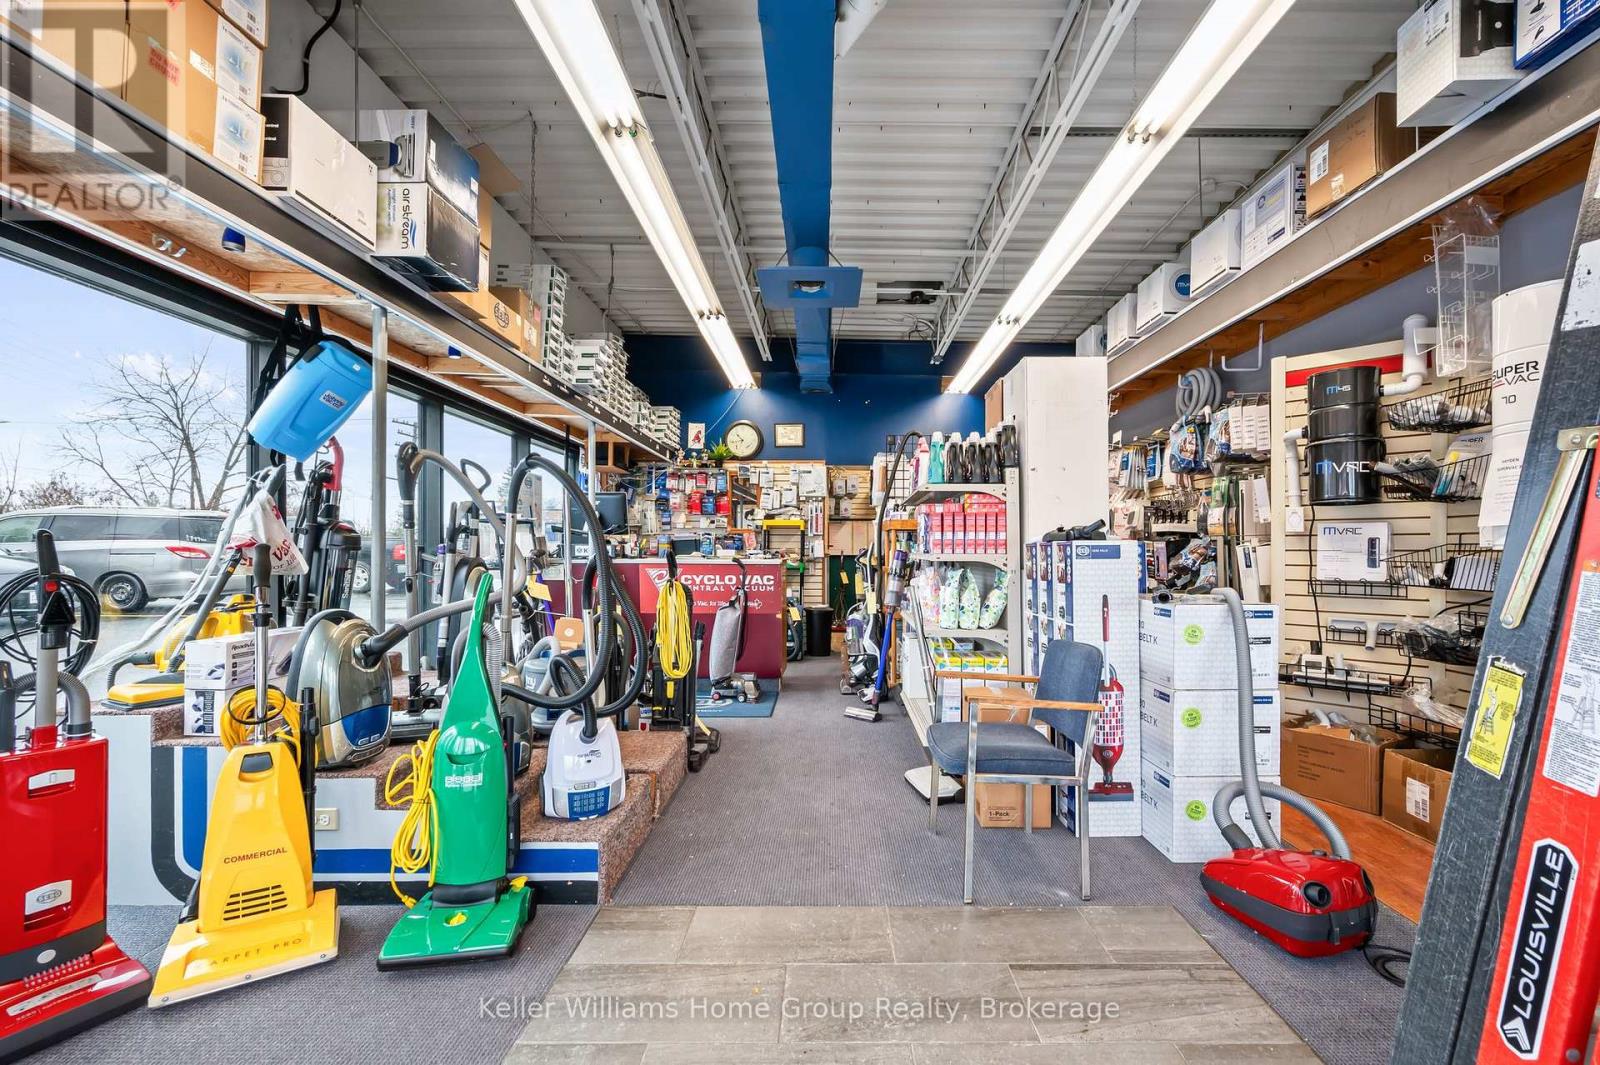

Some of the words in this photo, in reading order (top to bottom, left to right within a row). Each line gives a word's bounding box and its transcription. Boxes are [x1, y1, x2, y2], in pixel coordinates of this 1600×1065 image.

[400, 188, 413, 250] airstream
[1492, 360, 1540, 382] SUPER
[1504, 371, 1541, 386] VAC
[680, 575, 736, 585] CYCLO
[223, 847, 288, 864] COMMERCIAL
[1512, 847, 1565, 1020] LOUISVILLE
[273, 938, 302, 950] PRO
